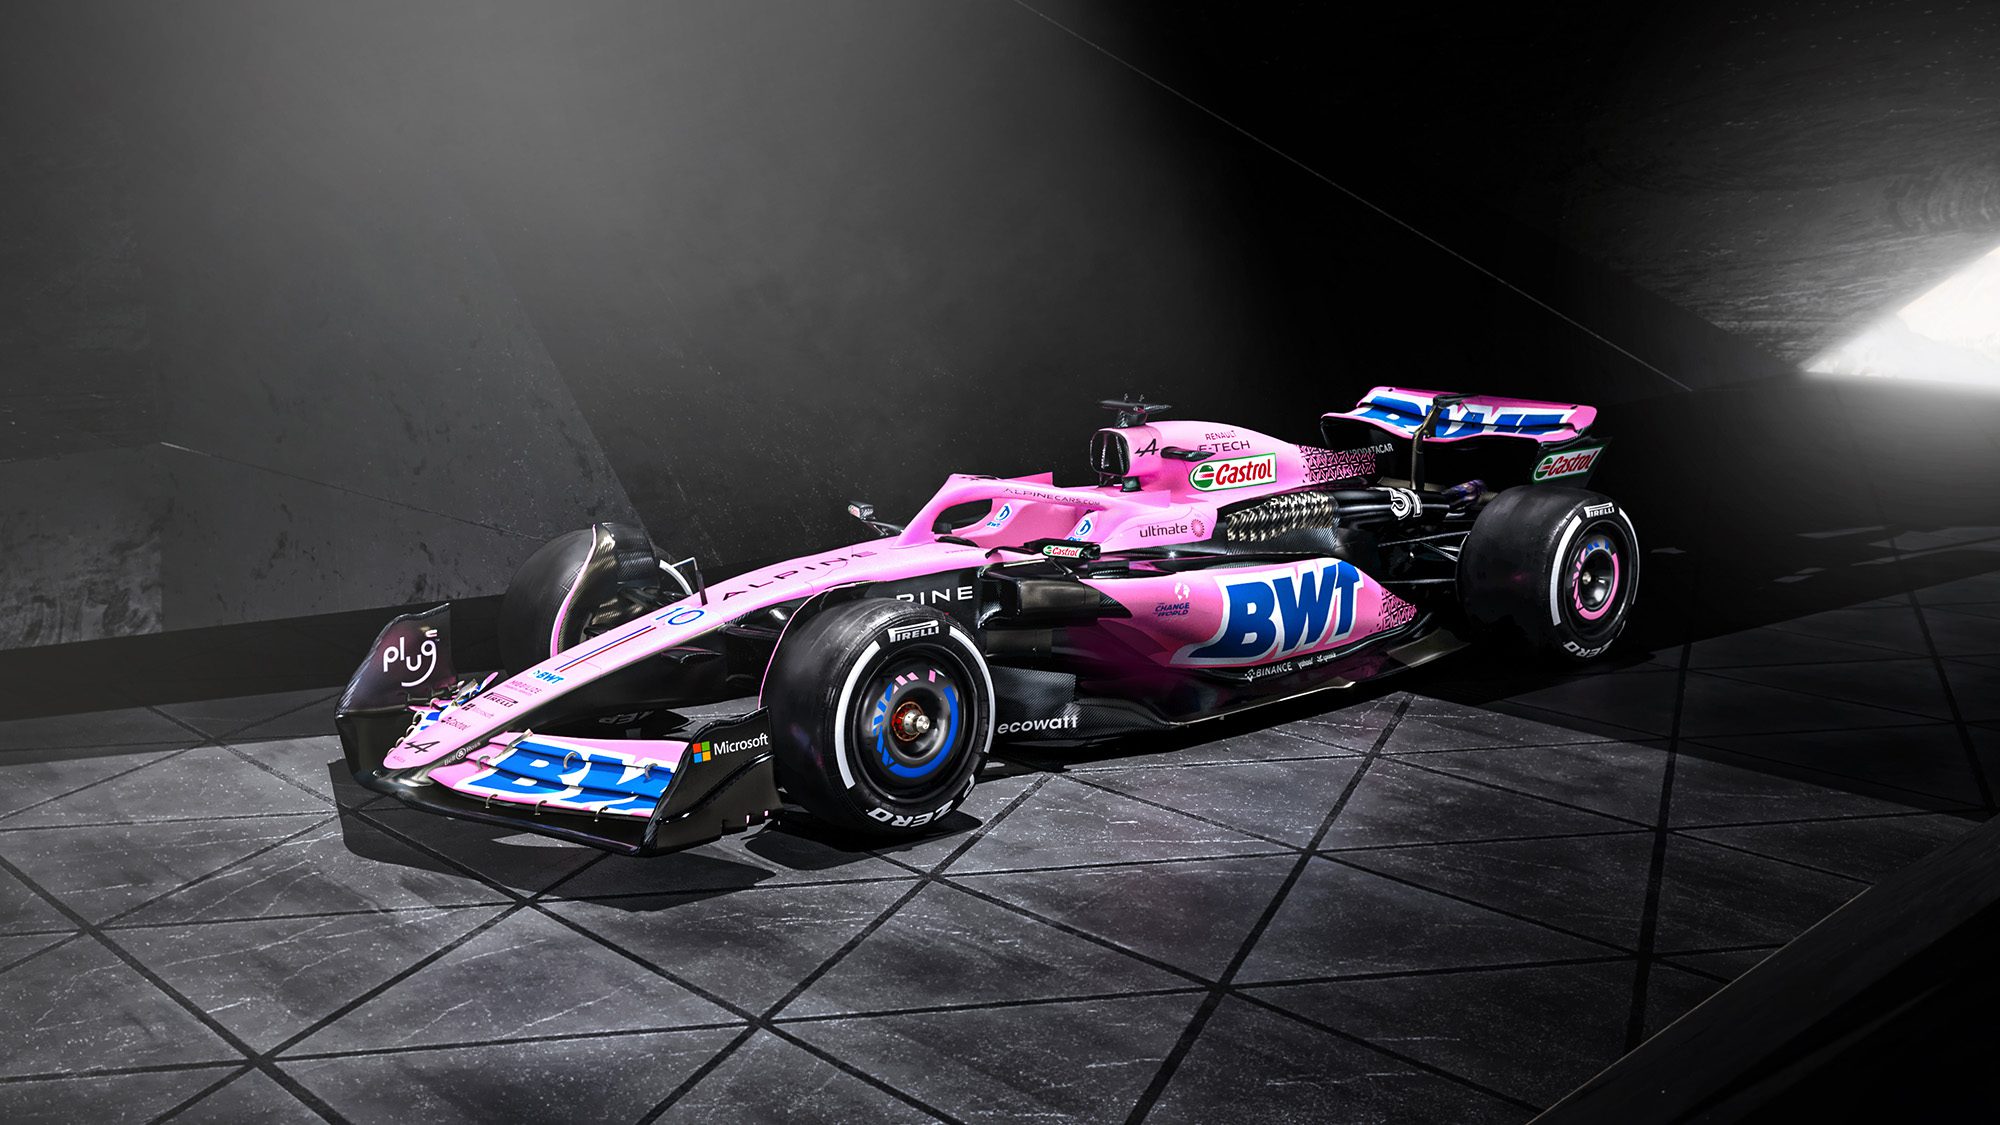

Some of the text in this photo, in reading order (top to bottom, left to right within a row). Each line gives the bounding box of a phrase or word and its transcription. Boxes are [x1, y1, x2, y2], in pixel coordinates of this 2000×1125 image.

[1205, 429, 1237, 441] RENAULT
[1215, 458, 1273, 486] Castrol
[1548, 450, 1597, 477] Castrol
[1583, 502, 1615, 518] PIRELLI
[1139, 523, 1189, 539] ultimate
[1051, 546, 1080, 558] Castrol
[722, 549, 879, 602] ALPINE
[655, 606, 706, 626] 10
[1154, 602, 1190, 612] CHANGE
[1184, 559, 1361, 660] BWT
[887, 619, 940, 643] PIRELLI
[383, 629, 440, 688] plug
[1256, 661, 1293, 677] BINANCE
[535, 669, 565, 685] BWT
[483, 691, 519, 708] PIRELLI
[997, 713, 1079, 735] ecowatt
[713, 732, 769, 756] Microsoft
[866, 799, 954, 828] ZERO
